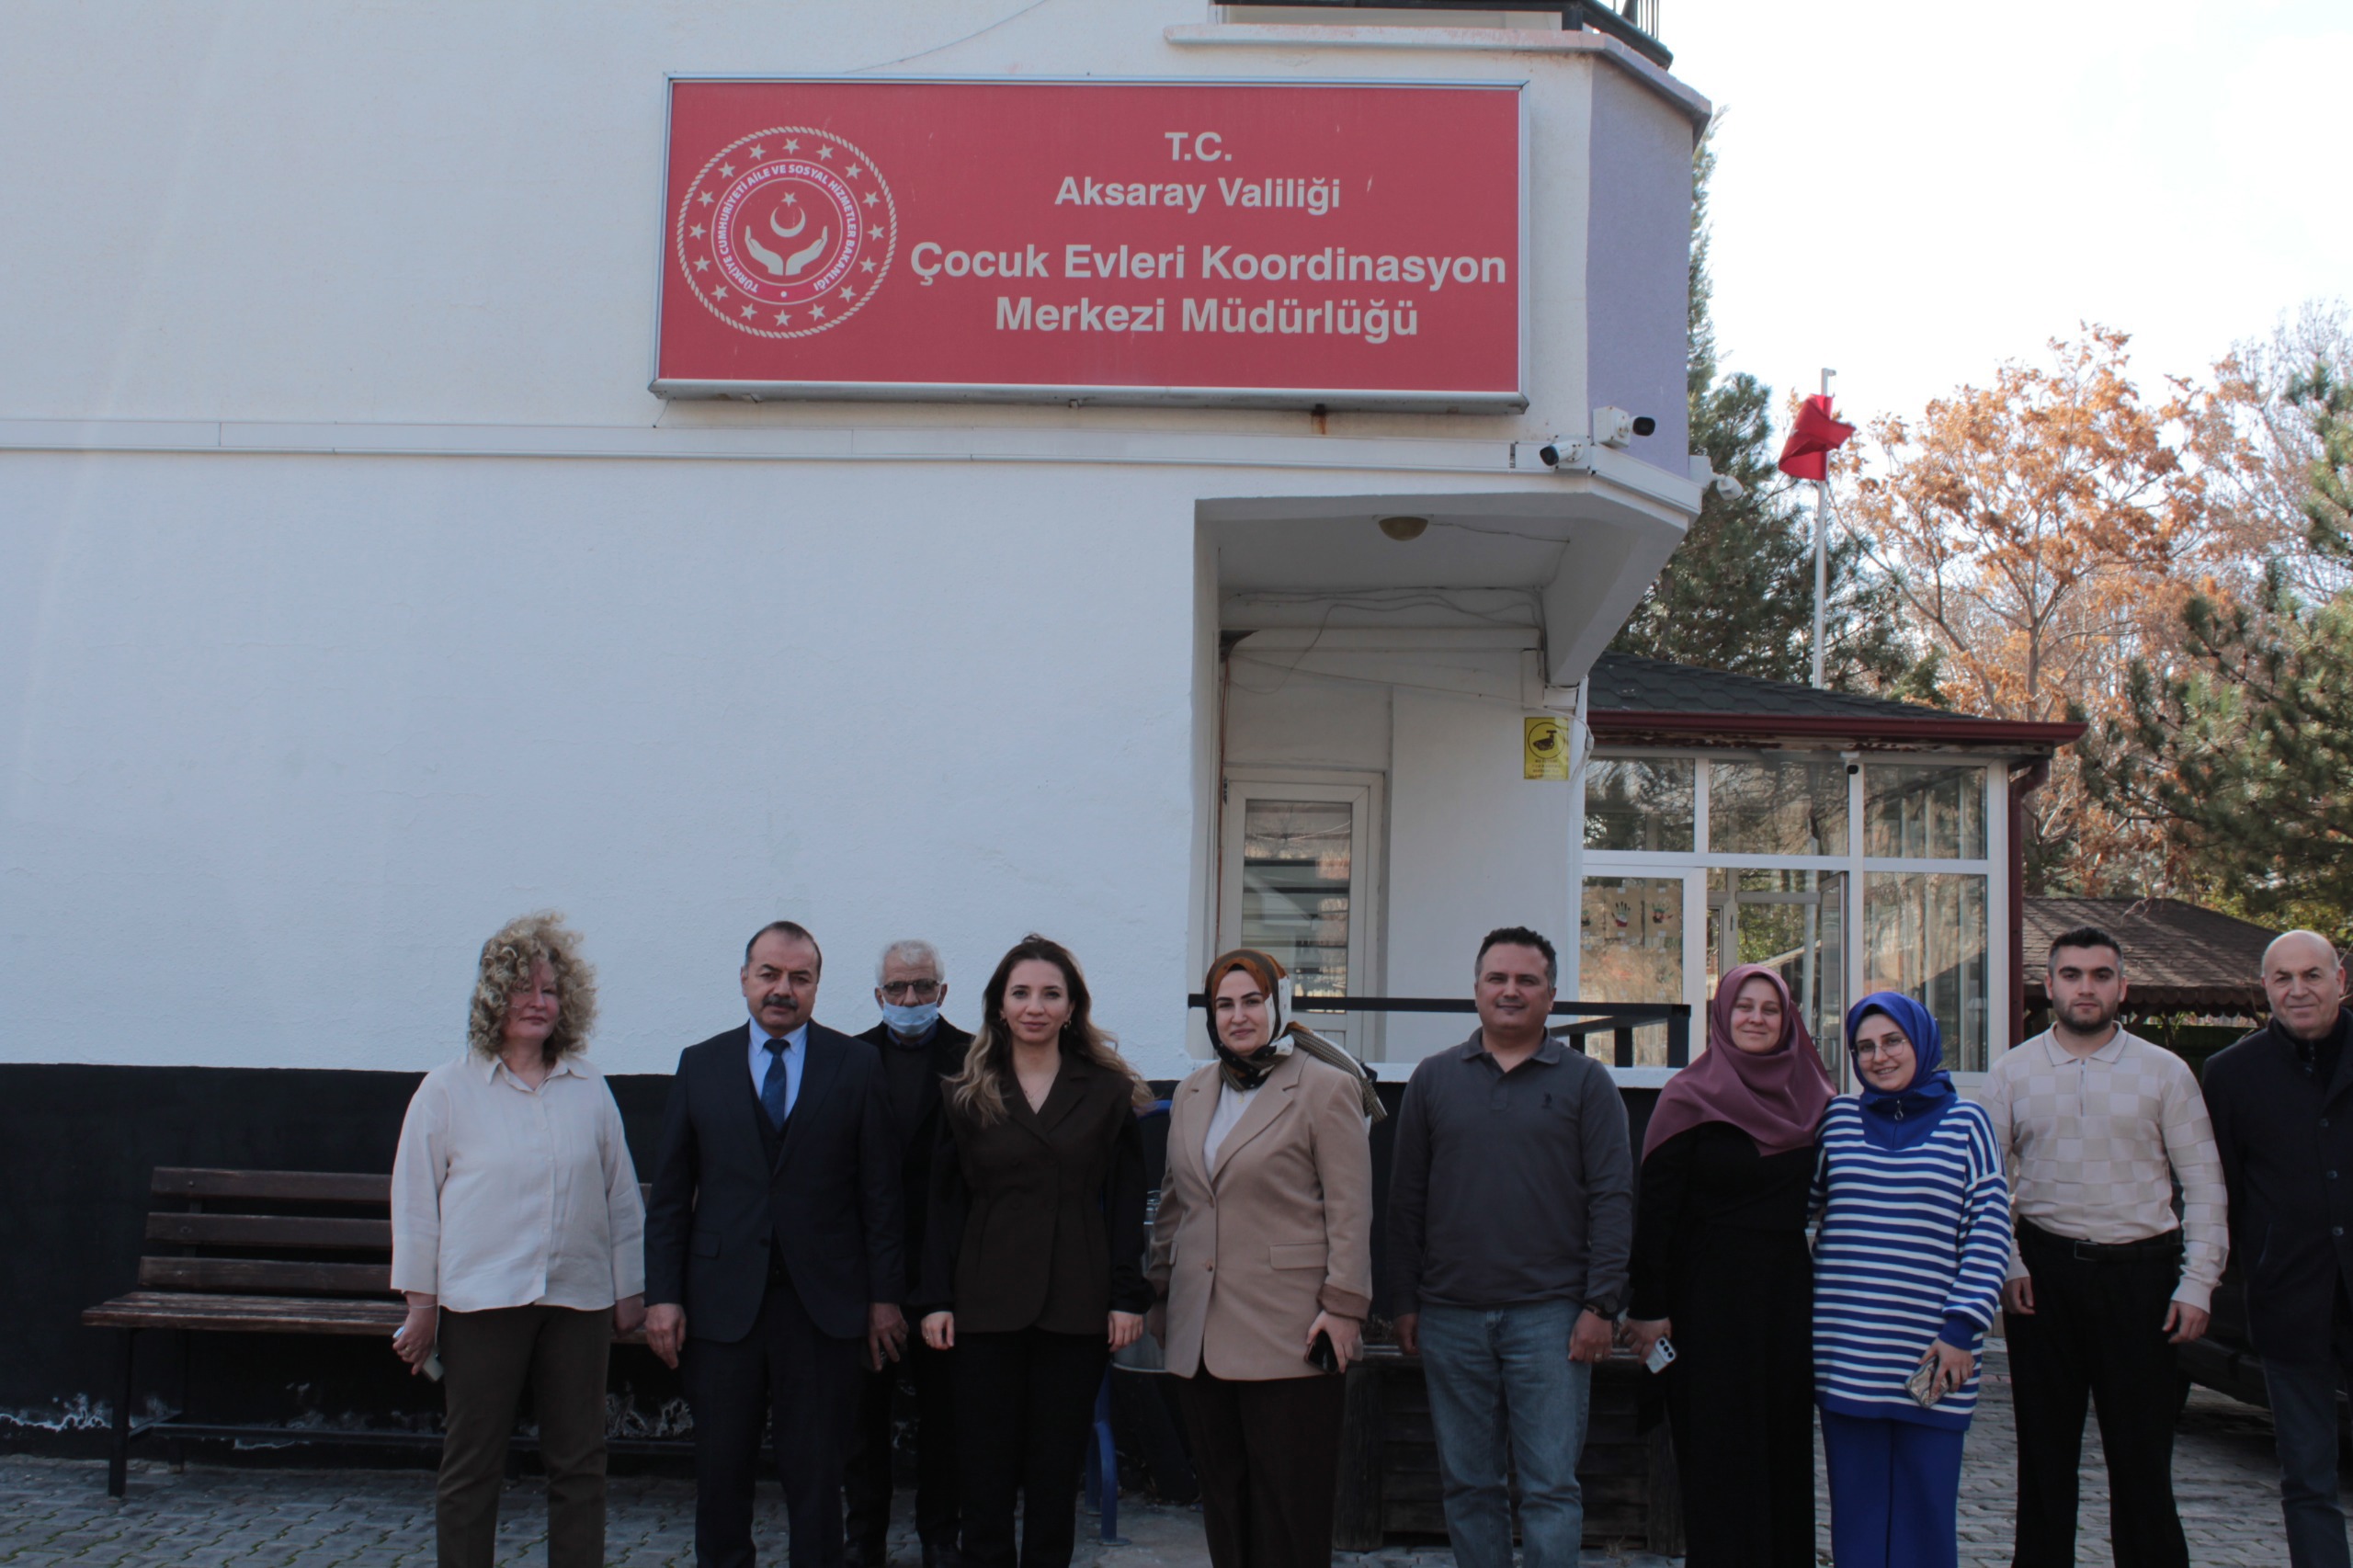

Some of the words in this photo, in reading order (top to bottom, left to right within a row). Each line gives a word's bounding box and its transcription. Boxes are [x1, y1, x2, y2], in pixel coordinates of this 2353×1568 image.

[1165, 131, 1233, 162] T.C.
[746, 168, 771, 187] AİLE
[771, 165, 787, 175] VE
[789, 165, 828, 185] SOSYAL
[827, 180, 857, 238] HİZMETLER
[1054, 176, 1207, 214] Aksaray
[1217, 176, 1340, 216] Valiliği
[718, 181, 748, 255] CUMHURİYETİ
[722, 256, 759, 293] TÜRKİYE
[813, 240, 856, 291] BAKANLIĞI
[910, 242, 1050, 287] Çocuk
[1064, 244, 1185, 279] Evleri
[1201, 244, 1506, 292] Koordinasyon
[996, 296, 1165, 332] Merkezi
[1182, 298, 1417, 345] Müdürlüğü
